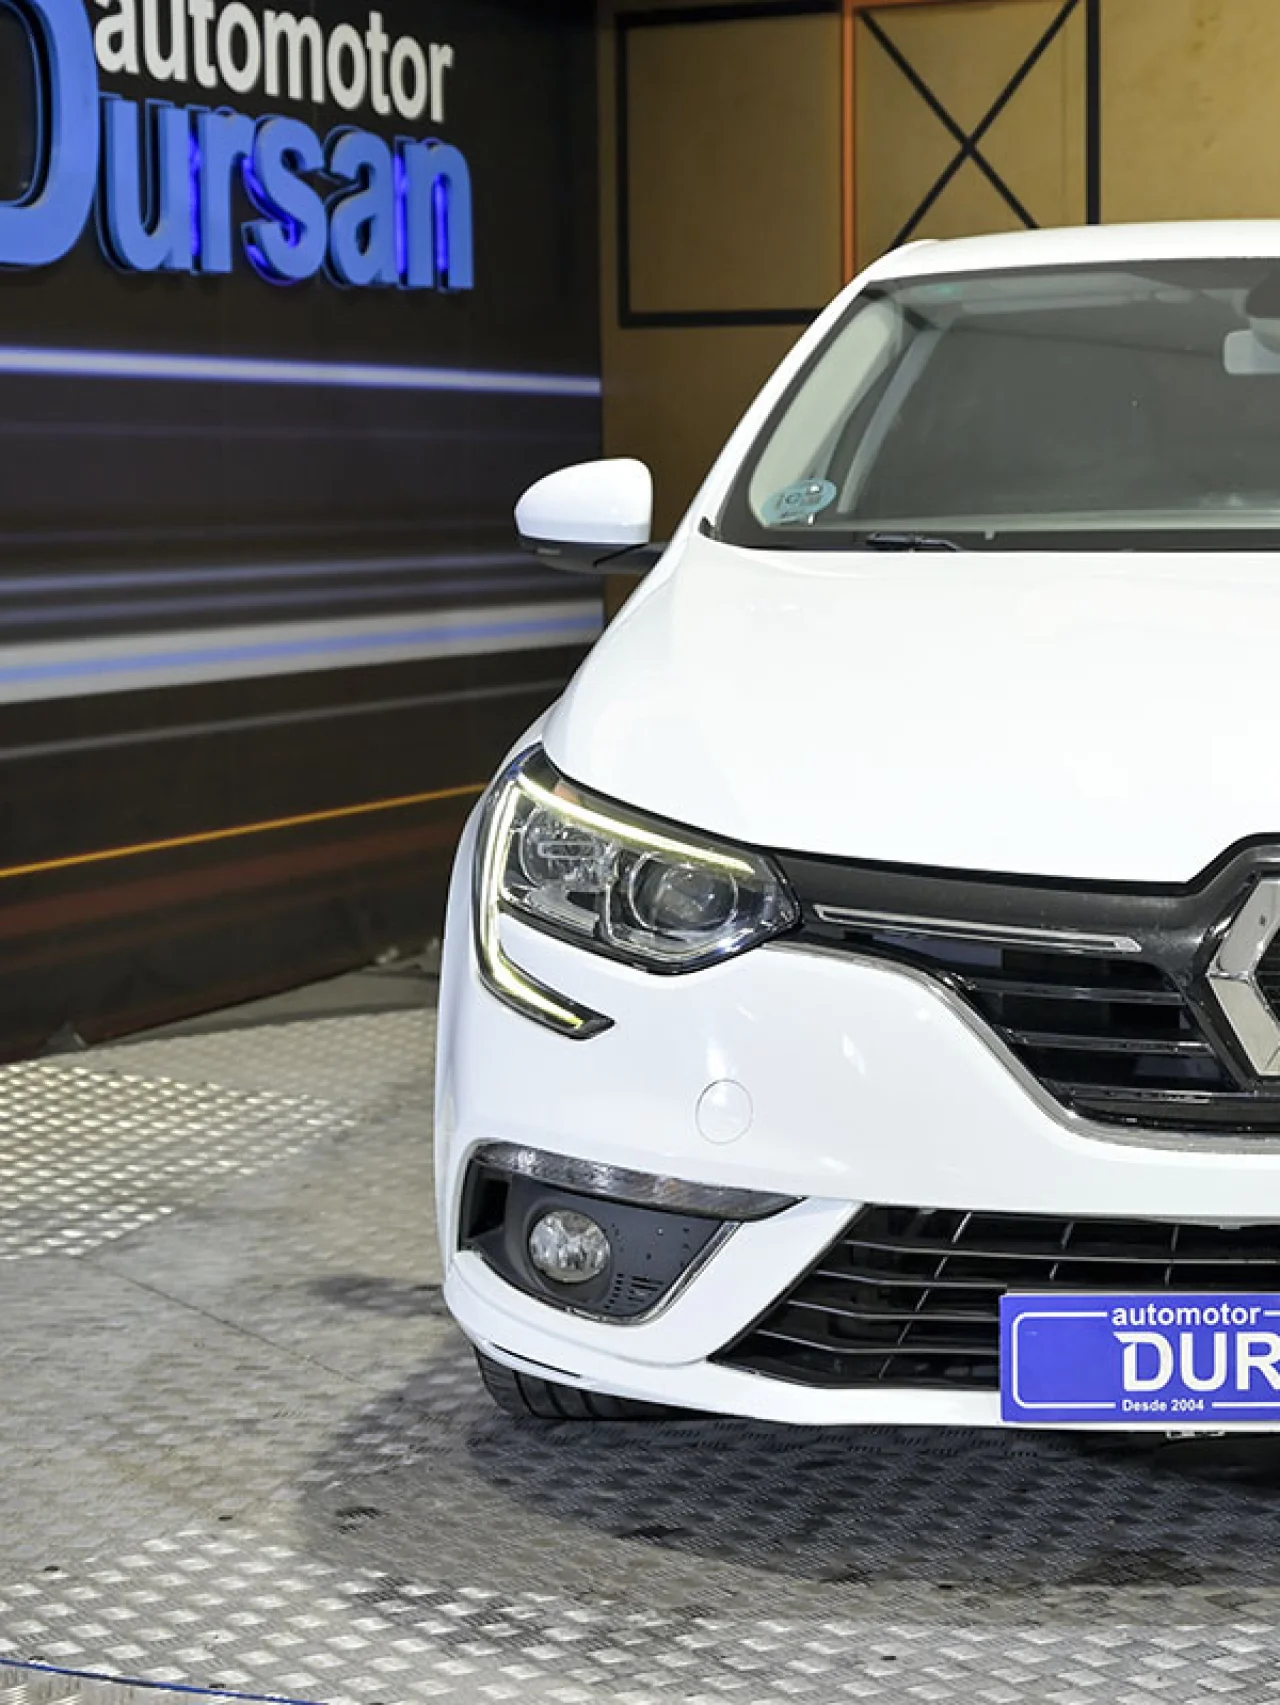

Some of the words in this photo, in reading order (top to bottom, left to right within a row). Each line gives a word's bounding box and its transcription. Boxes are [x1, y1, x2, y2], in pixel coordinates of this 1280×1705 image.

[94, 0, 454, 122] automotor
[1112, 1303, 1261, 1326] automotor
[1122, 1399, 1167, 1412] Desde
[1170, 1399, 1204, 1412] 2004
